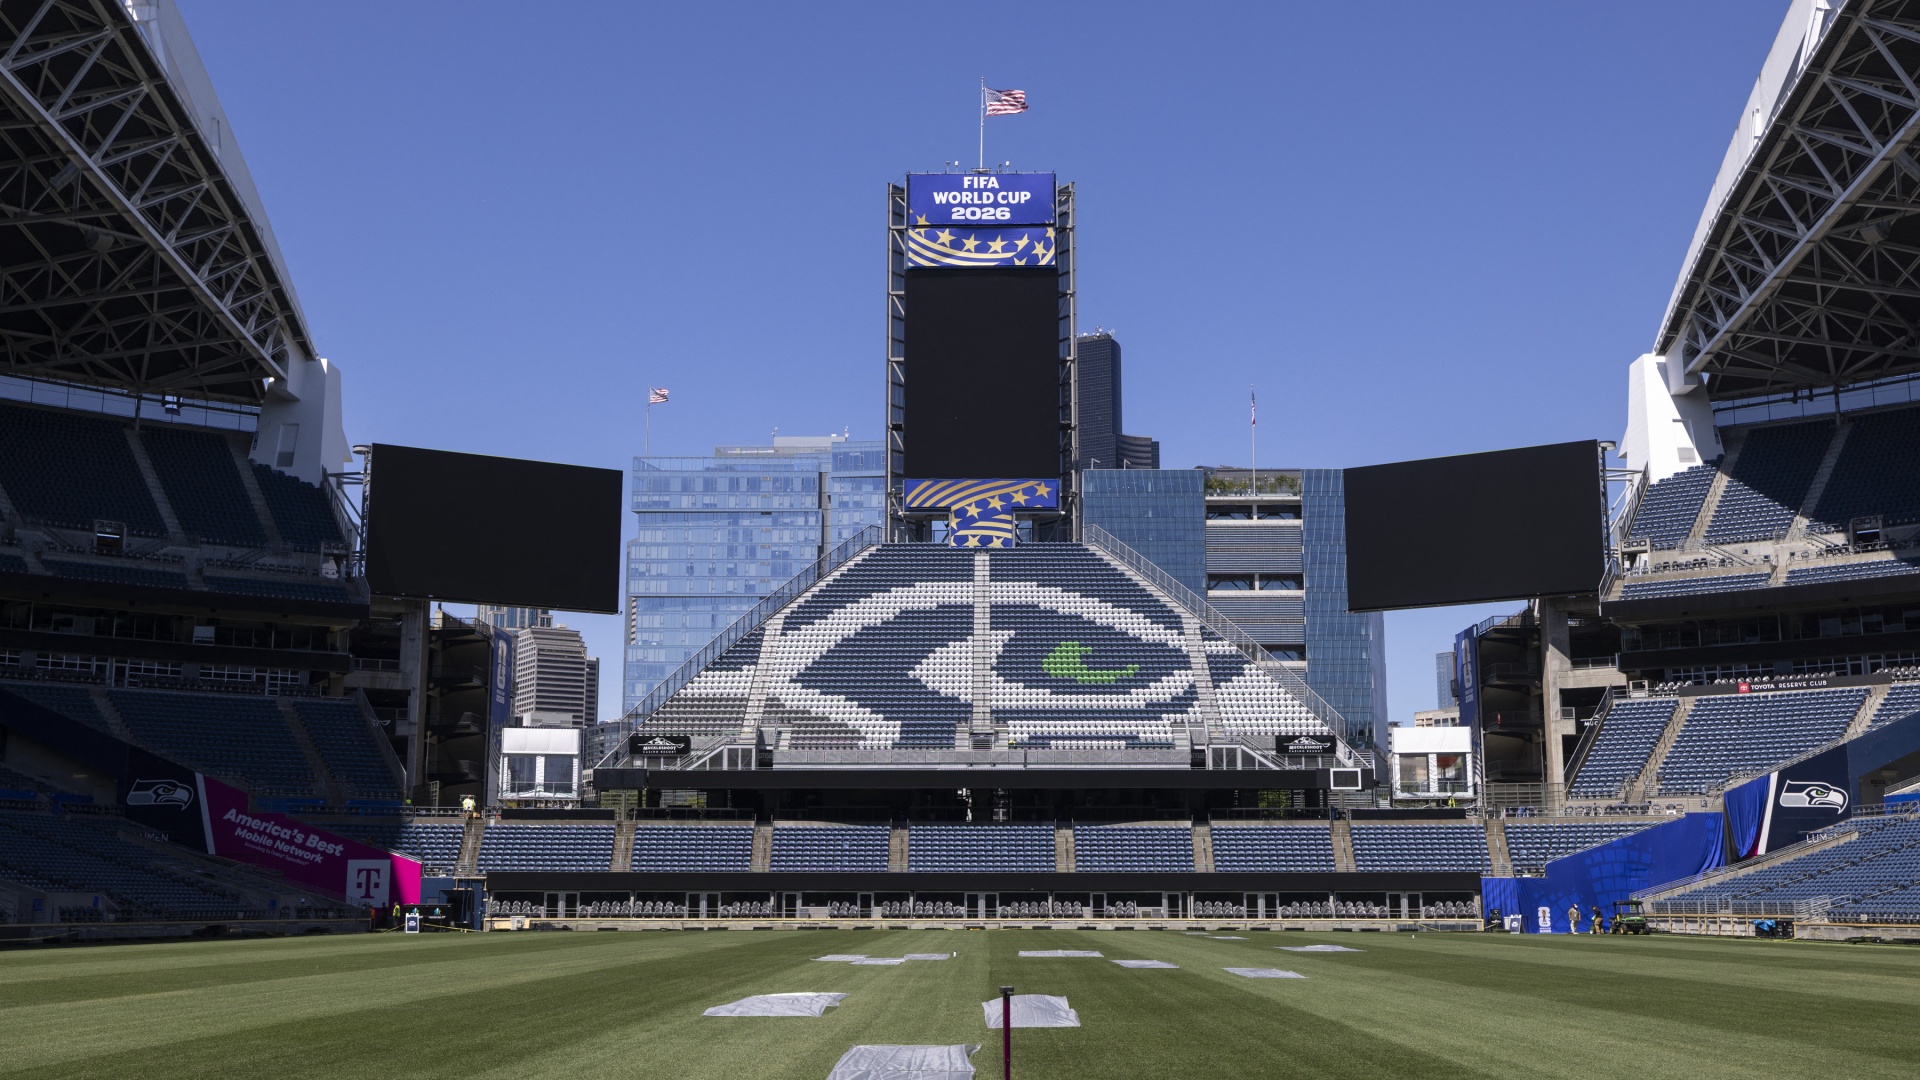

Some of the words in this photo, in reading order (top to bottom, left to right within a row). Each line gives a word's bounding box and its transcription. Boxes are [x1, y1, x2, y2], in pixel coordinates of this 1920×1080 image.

[963, 176, 1000, 189] FIFA
[933, 191, 994, 205] WORLD
[997, 191, 1031, 205] CUP
[951, 206, 1011, 220] 2026
[1623, 540, 1647, 548] 300
[1778, 681, 1807, 689] RESERVE
[234, 827, 274, 847] Mobile
[274, 840, 324, 864] Network
[305, 833, 345, 857] Best
[357, 868, 380, 899] T
